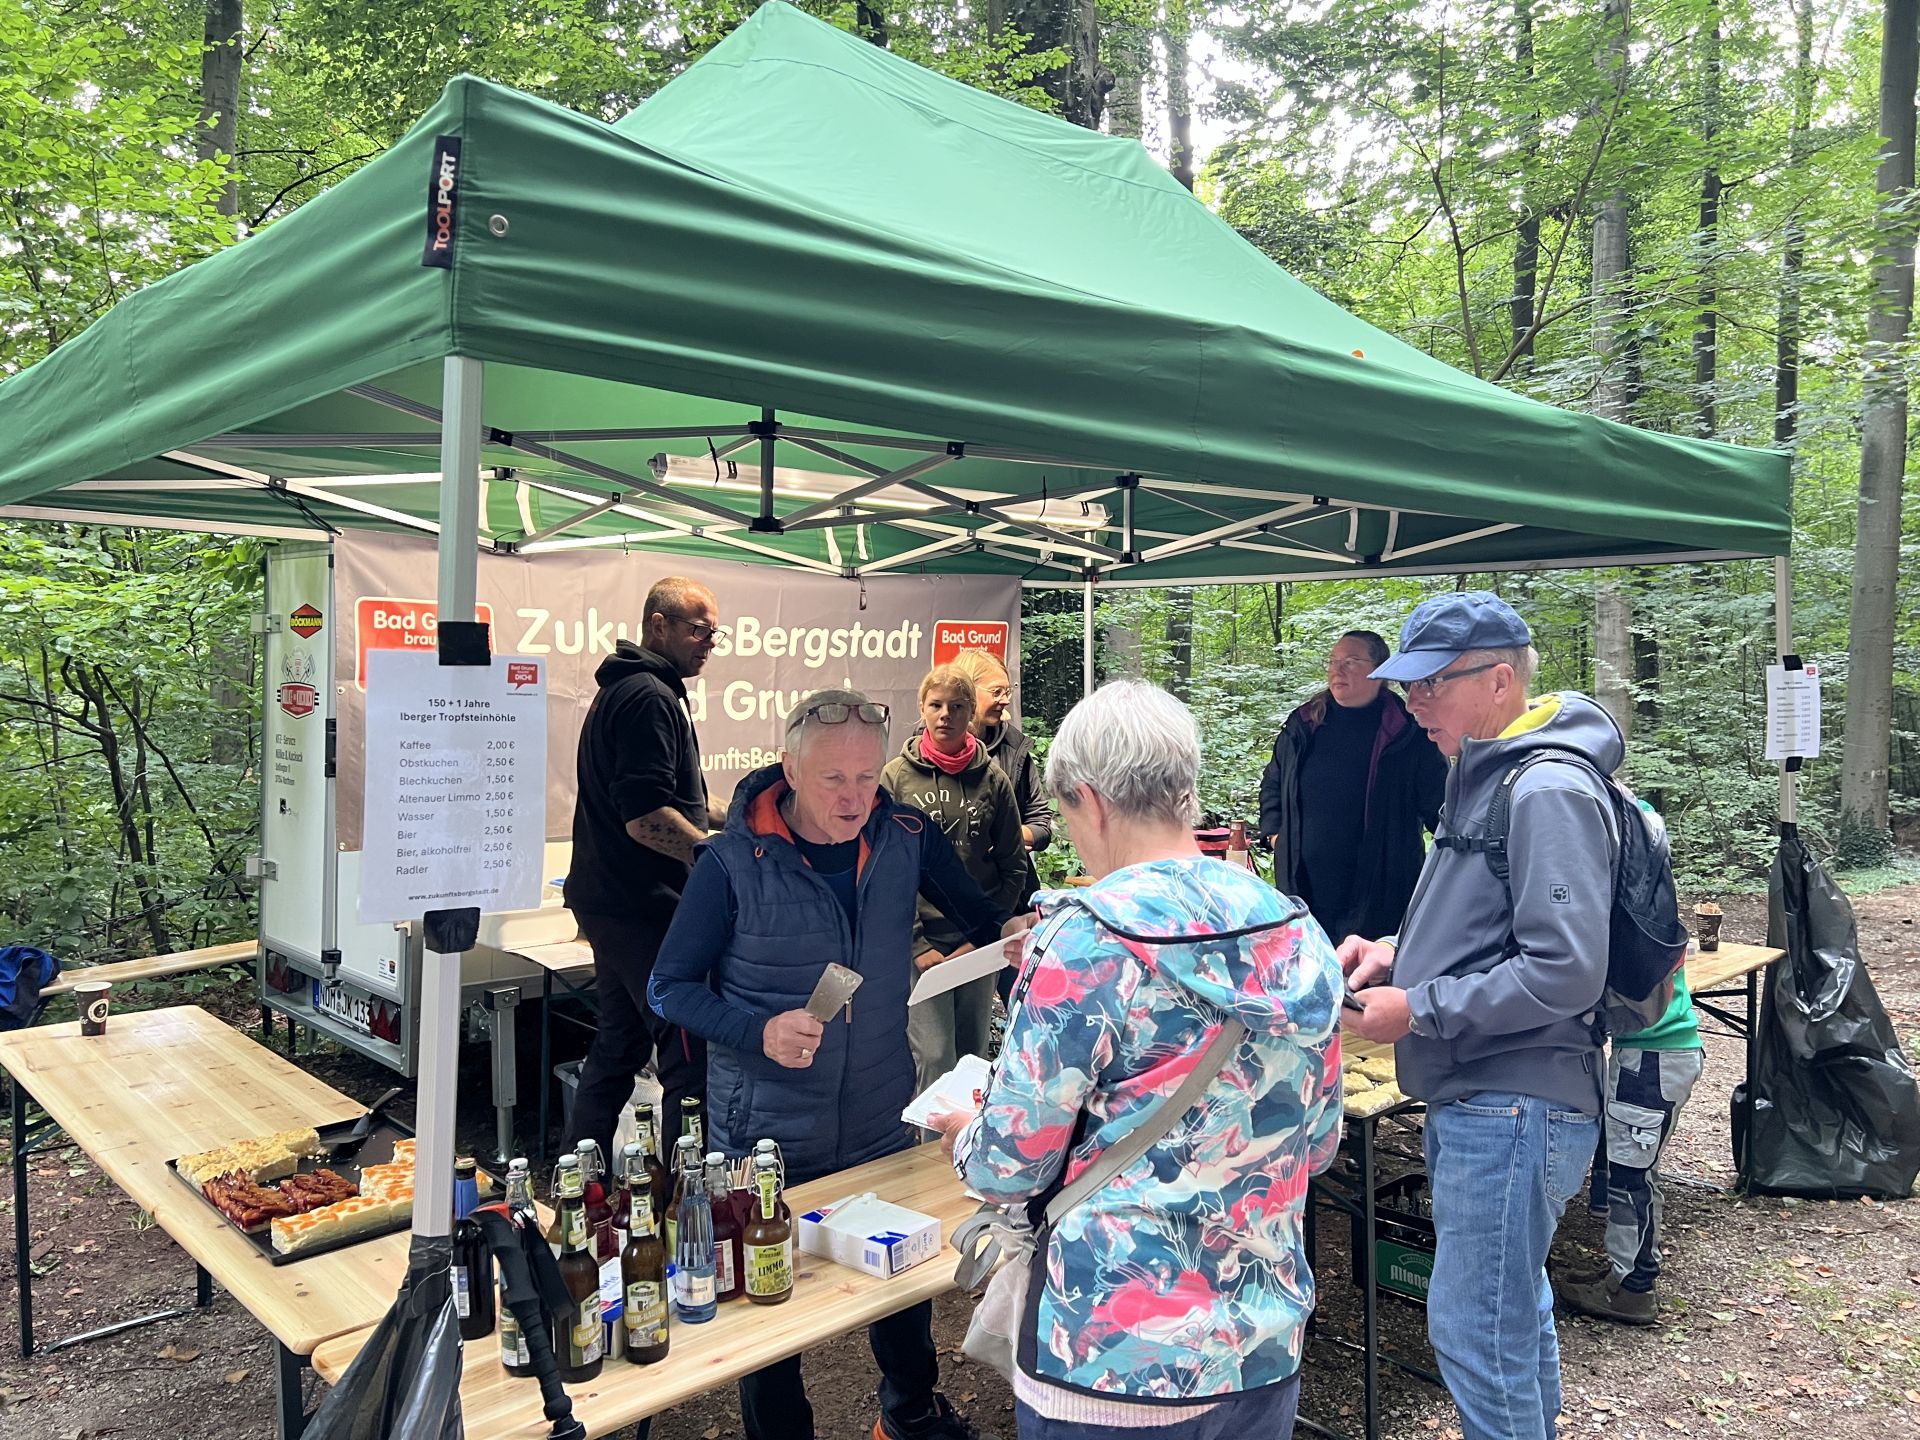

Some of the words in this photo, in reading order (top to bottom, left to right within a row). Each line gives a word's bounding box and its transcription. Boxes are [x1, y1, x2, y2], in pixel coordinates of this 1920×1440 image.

[433, 151, 457, 251] TOOLPORT
[373, 609, 416, 630] Bad
[404, 631, 438, 646] brau
[941, 629, 966, 644] Bad
[967, 629, 1002, 644] Grund
[428, 699, 446, 708] 150
[456, 700, 462, 708] 1
[464, 700, 491, 708] Jahre
[400, 712, 436, 723] Iberger
[438, 712, 516, 723] Tropfsteinhöhle
[399, 741, 432, 750] Kaffee
[487, 741, 507, 750] 2,00
[509, 741, 515, 750] €
[399, 758, 459, 768] Obstkuchen
[486, 758, 507, 767] 2,50
[508, 757, 515, 766] €
[399, 776, 463, 786] Blechkuchen
[486, 775, 507, 785] 1,50
[508, 774, 515, 784] €
[398, 793, 446, 804] Altenauer
[447, 792, 481, 802] Limmo
[485, 792, 506, 801] 2,50
[507, 791, 514, 800] €
[397, 812, 435, 822] Wasser
[485, 808, 506, 818] 1,50
[507, 808, 514, 817] €
[397, 830, 417, 840] Bier
[484, 826, 505, 836] 2,50
[506, 825, 513, 834] €
[396, 848, 419, 858] Bier,
[420, 844, 472, 856] alkoholfrei
[484, 843, 505, 852] 2,50
[506, 842, 513, 851] €
[395, 865, 429, 876] Radler
[483, 859, 504, 870] 2,50
[505, 859, 512, 868] €
[407, 887, 499, 901] www.zukunftsbergstadt.de
[341, 991, 353, 1019] JK
[758, 1258, 784, 1277] LIMMO
